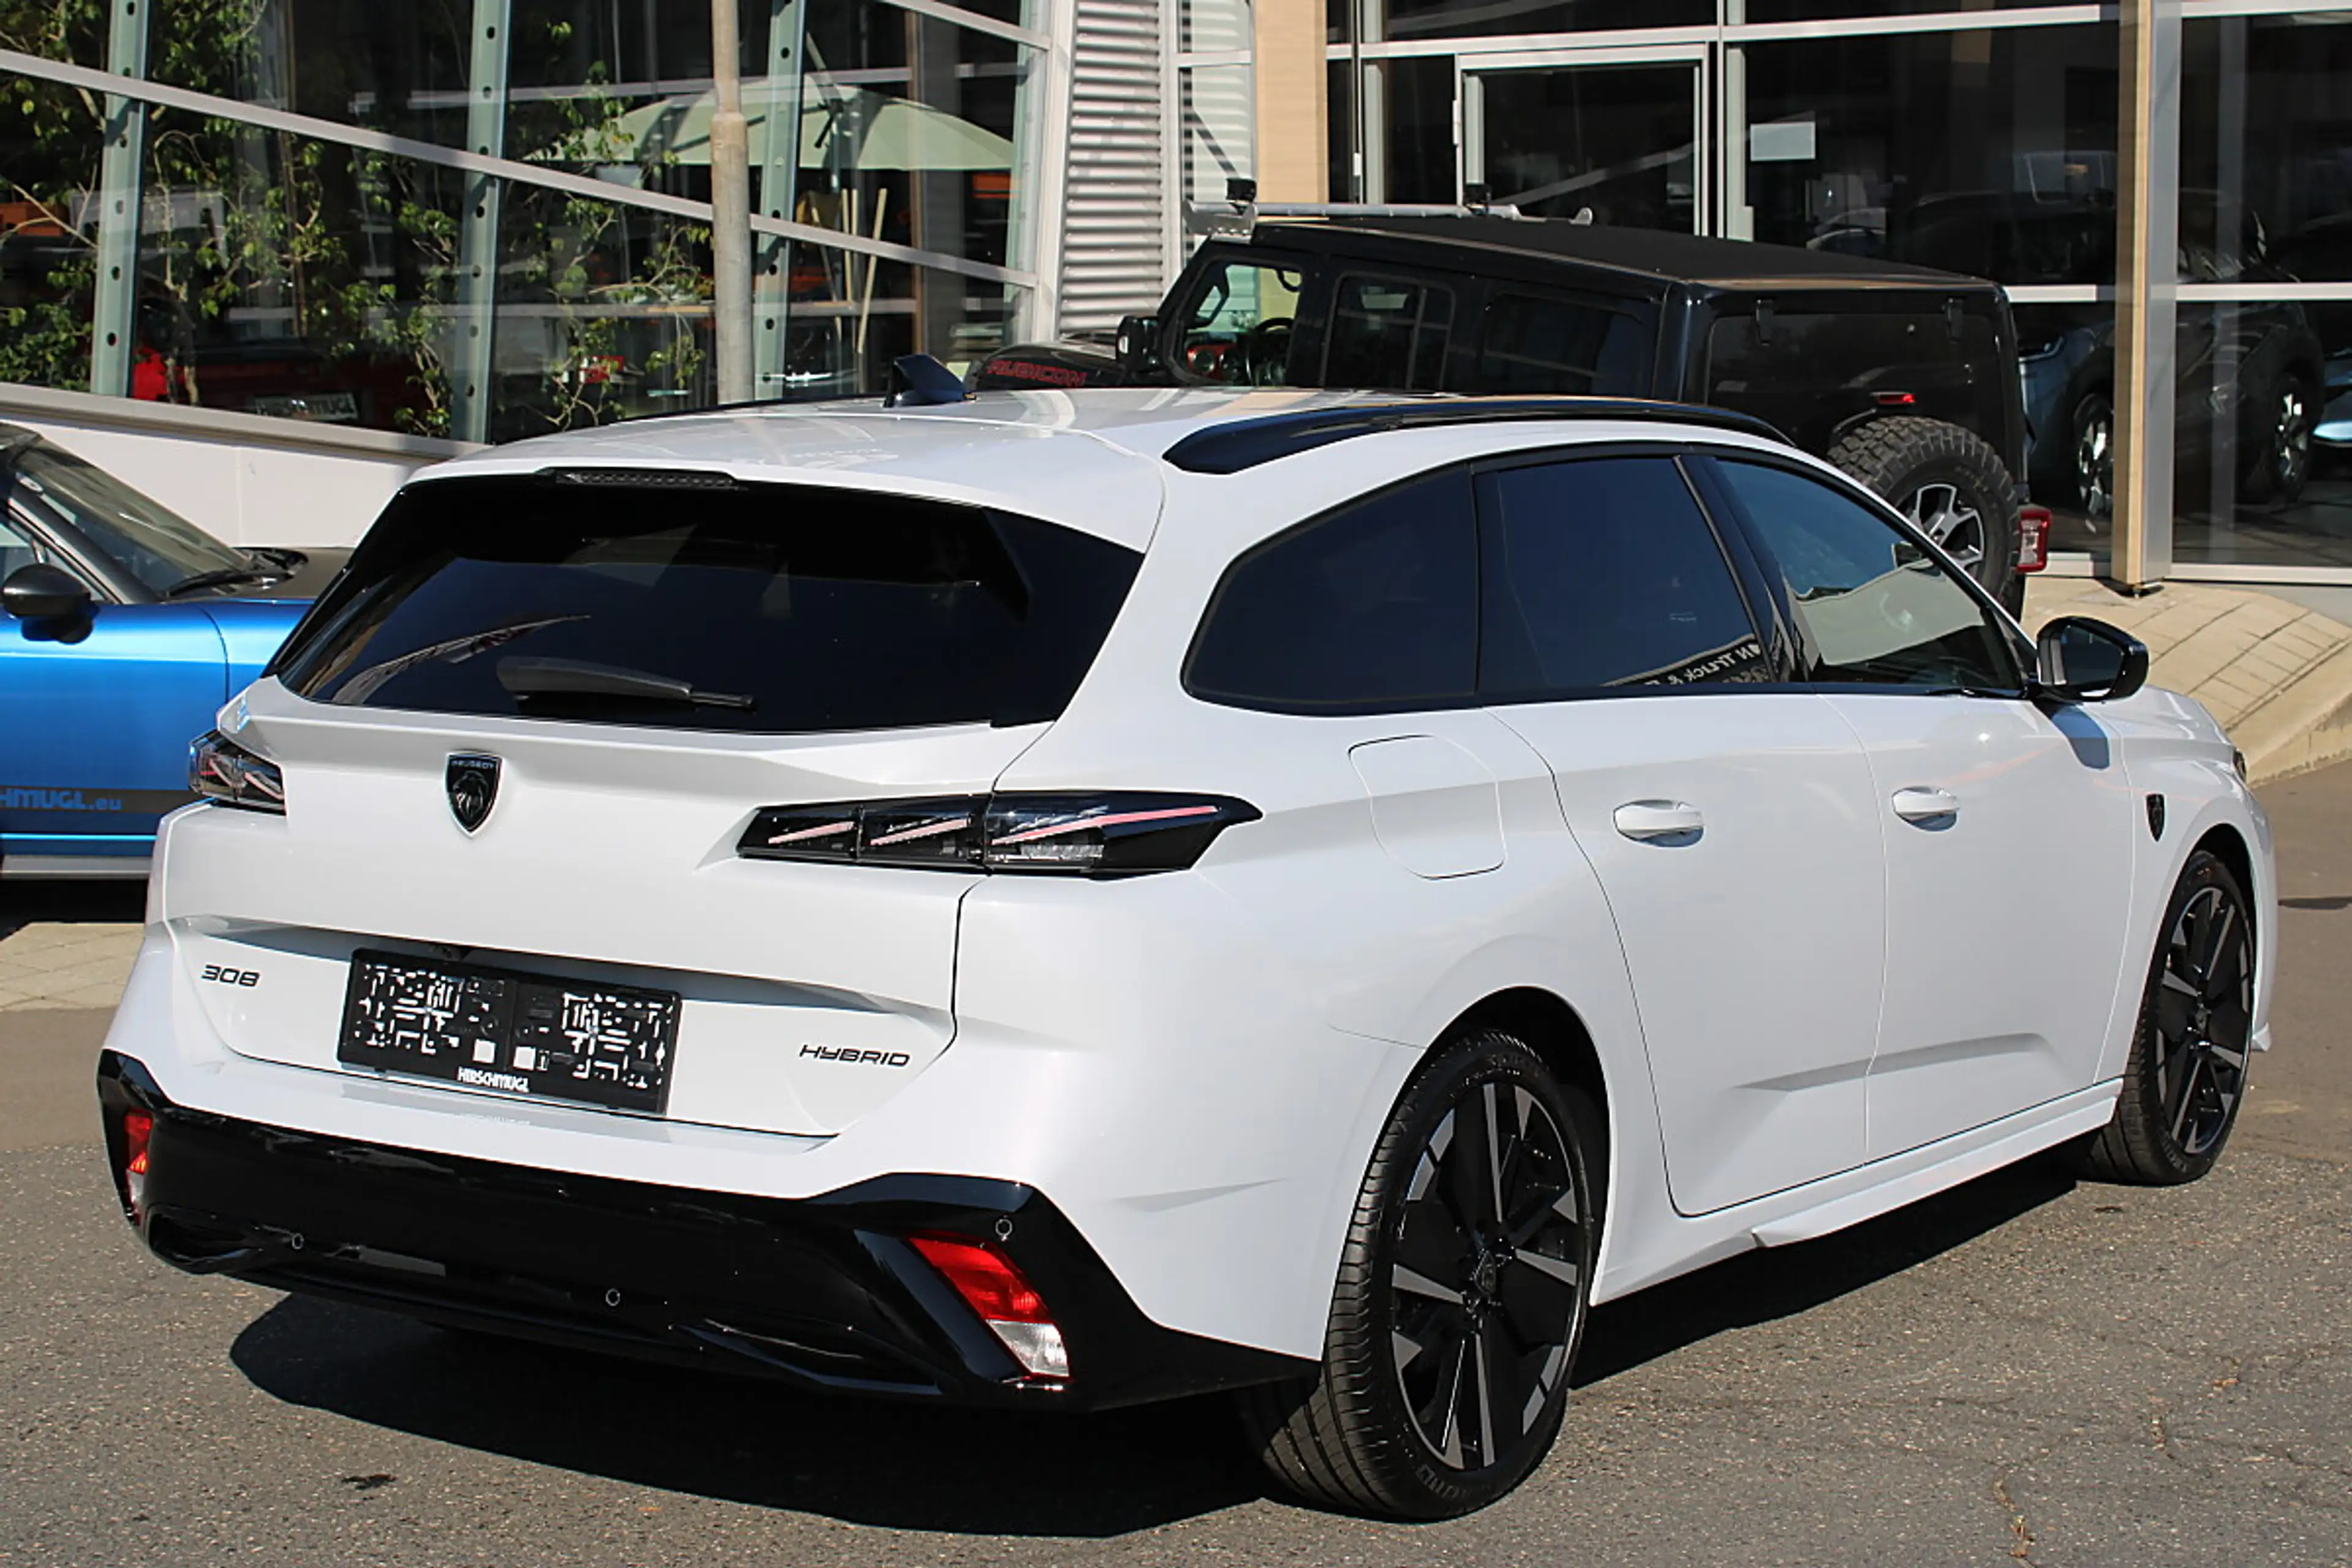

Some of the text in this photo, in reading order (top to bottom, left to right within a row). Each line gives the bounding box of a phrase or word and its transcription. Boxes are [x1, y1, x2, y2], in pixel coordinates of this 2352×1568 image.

[986, 360, 1088, 387] RUBICON
[201, 964, 260, 987] 308
[799, 1044, 911, 1068] HYBRID
